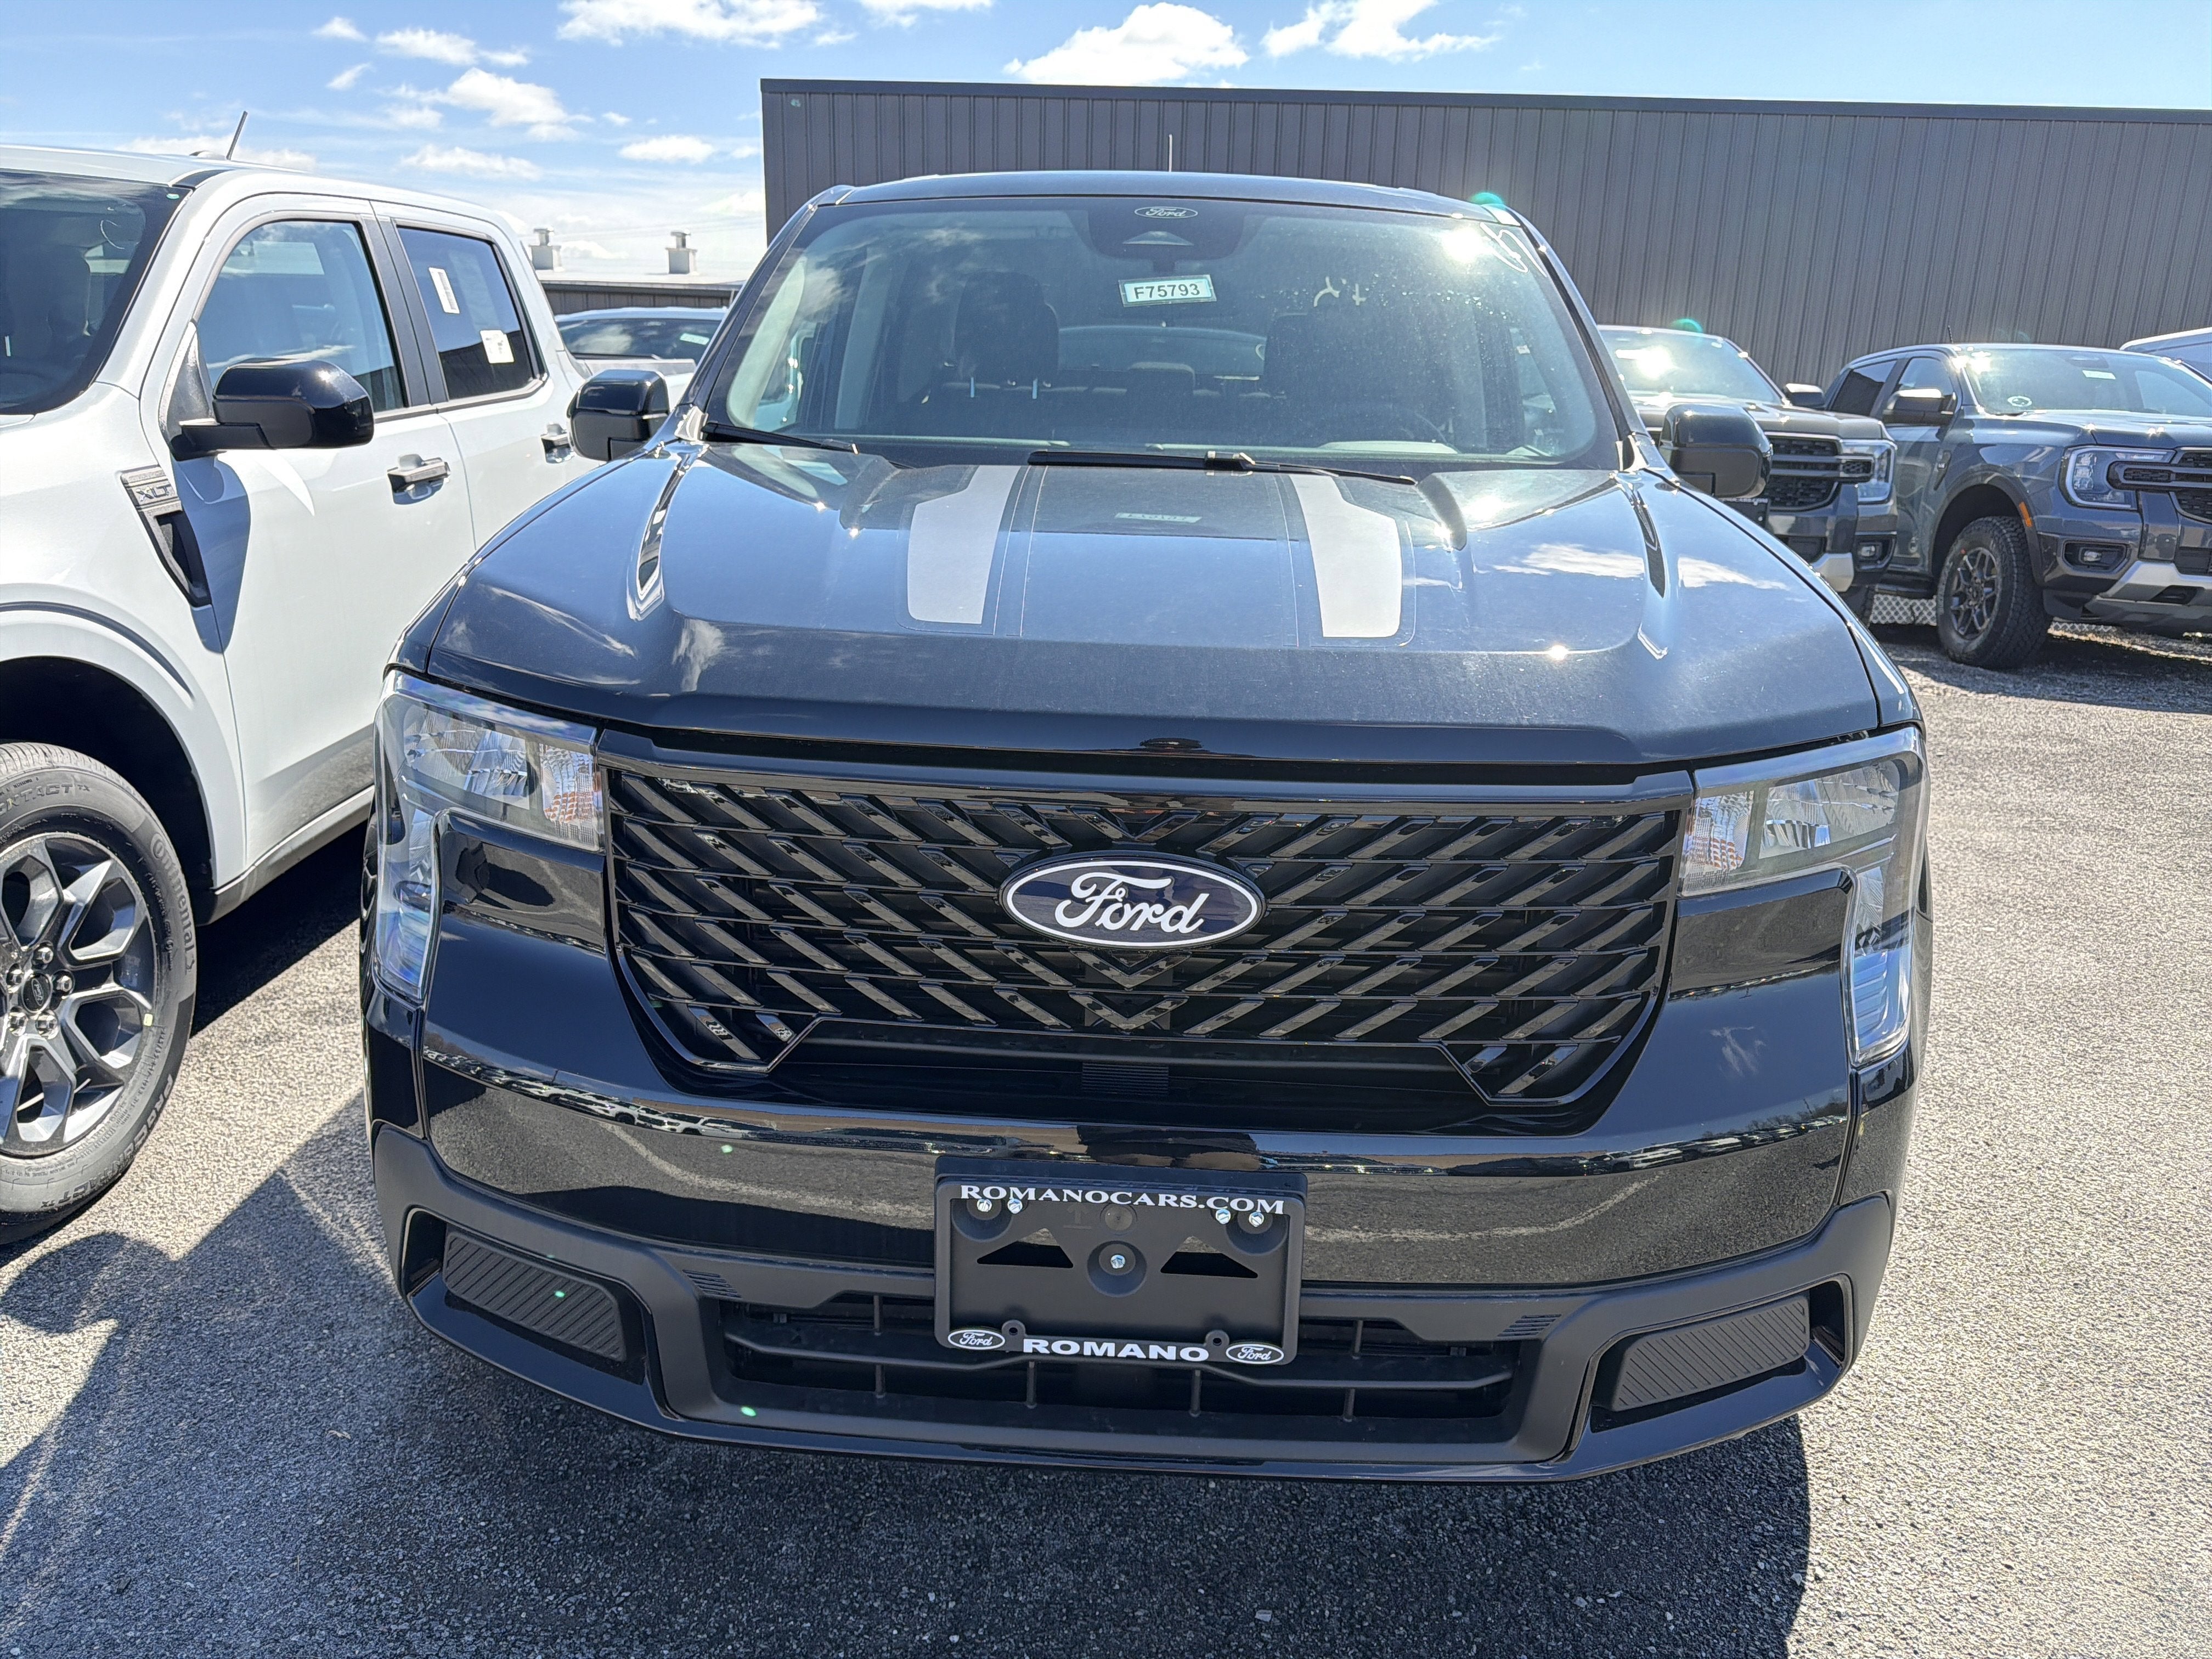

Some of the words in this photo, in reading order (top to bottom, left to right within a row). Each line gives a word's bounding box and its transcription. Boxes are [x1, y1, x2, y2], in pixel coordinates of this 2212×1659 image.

[1145, 207, 1187, 217] Ford
[1133, 283, 1200, 300] F75793
[136, 485, 172, 501] XLT
[150, 833, 195, 953] Continental
[1054, 871, 1210, 934] Ford
[961, 1184, 1284, 1215] ROMANOCARS.COM
[959, 1331, 993, 1347] Ford
[1023, 1338, 1210, 1362] ROMANO
[1237, 1346, 1272, 1362] Ford
